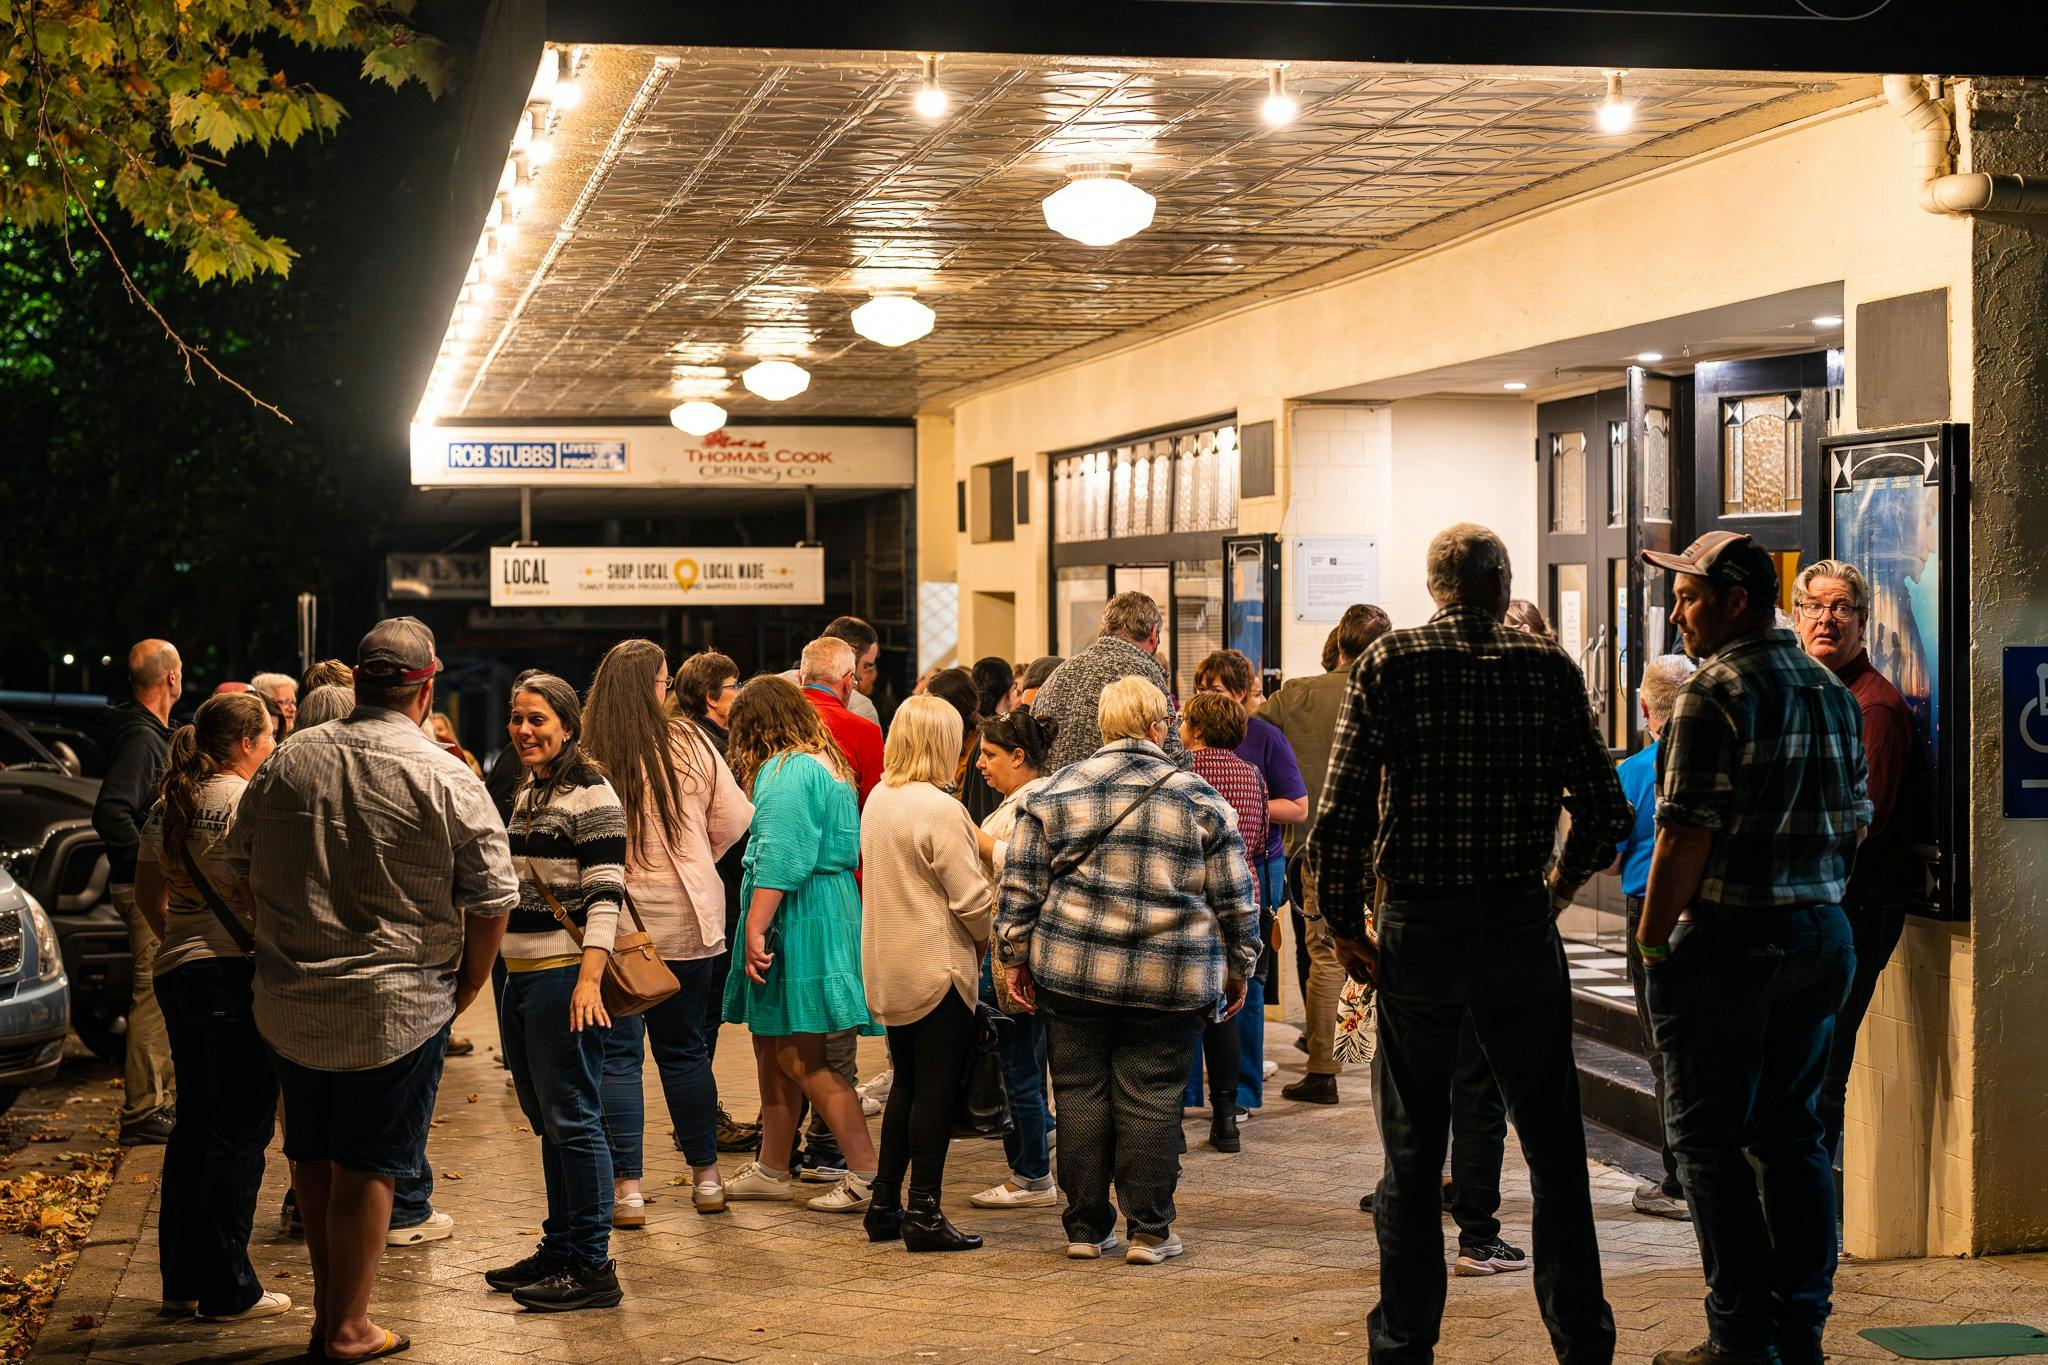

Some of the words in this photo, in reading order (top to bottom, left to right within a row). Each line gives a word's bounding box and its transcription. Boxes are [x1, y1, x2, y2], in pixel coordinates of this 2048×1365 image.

[450, 444, 486, 467] ROB
[489, 445, 554, 467] STUBBS
[684, 449, 770, 463] THOMAS
[775, 449, 833, 463] COOK
[699, 466, 781, 482] CLOTHING
[504, 559, 549, 584] LOCAL
[608, 563, 633, 579] SHOP
[637, 563, 669, 579] LOCAL
[703, 563, 734, 579] LOCAL
[738, 563, 764, 579] MADE
